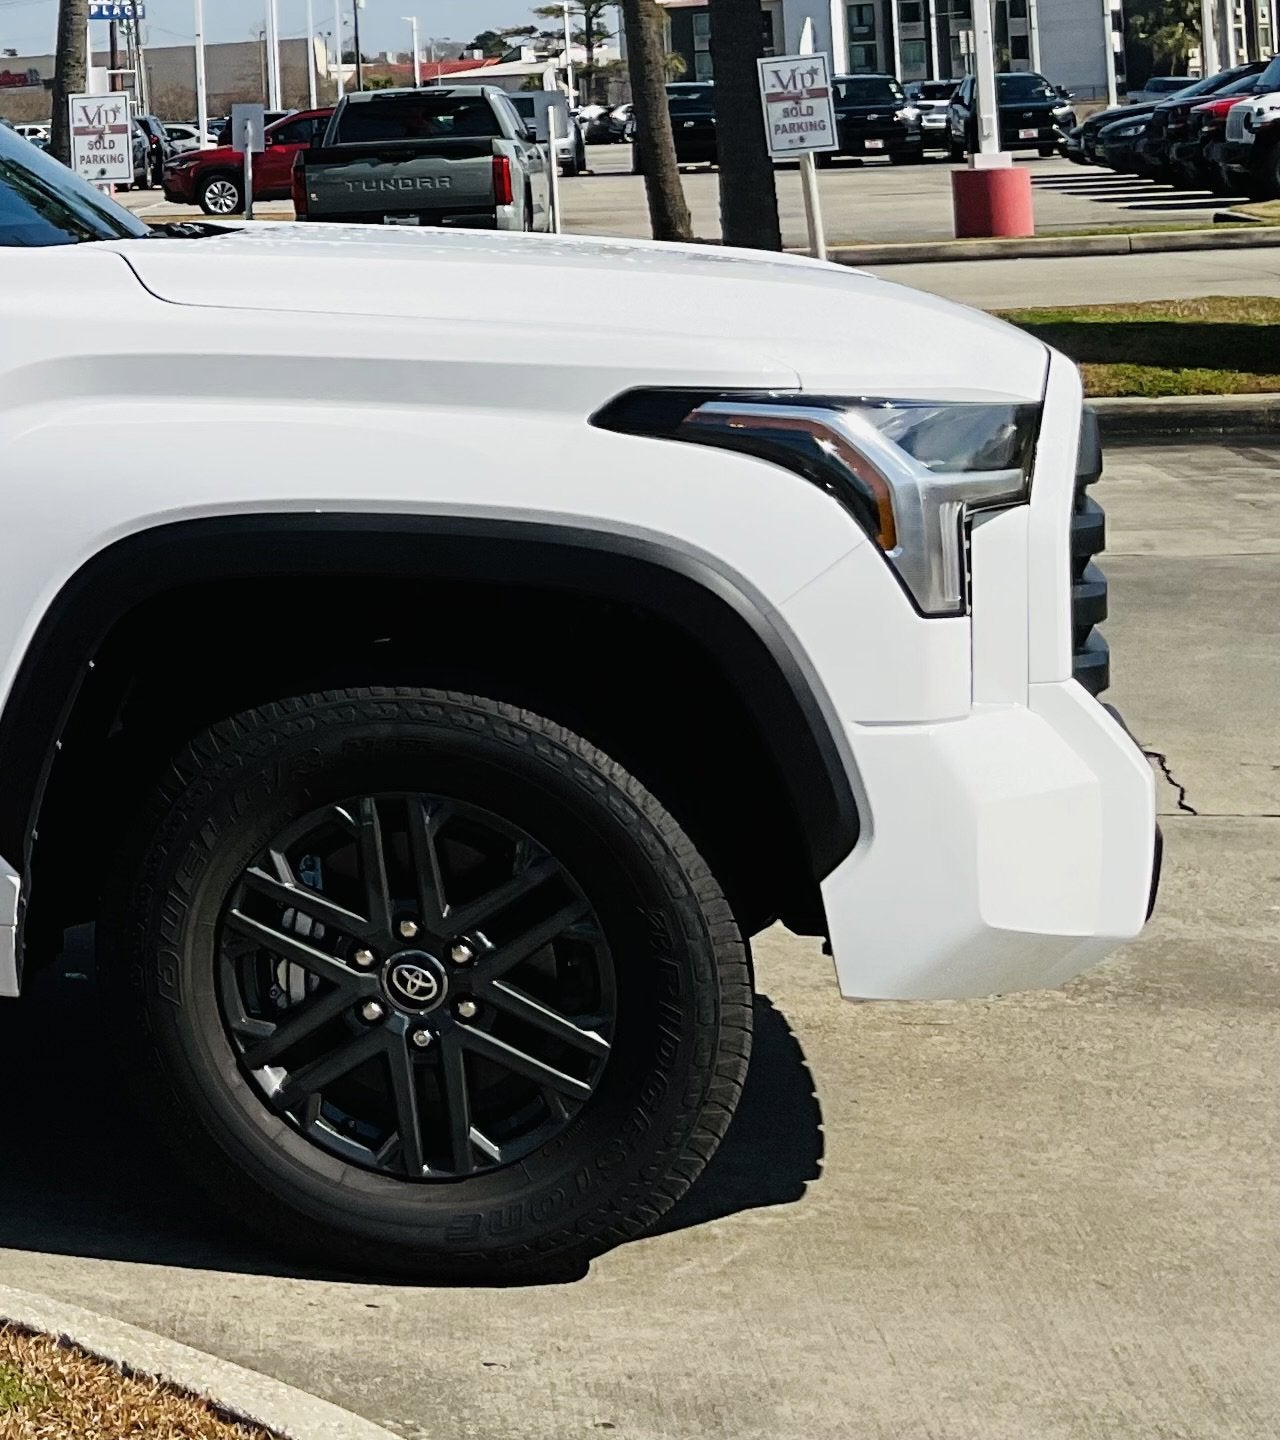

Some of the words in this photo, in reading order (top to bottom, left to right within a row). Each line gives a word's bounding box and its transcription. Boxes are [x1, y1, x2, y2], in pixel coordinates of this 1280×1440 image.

[782, 106, 814, 118] SOLD
[774, 120, 826, 135] PARKING
[87, 140, 115, 150] SOLD
[80, 153, 125, 165] PARKING
[344, 175, 452, 193] TUNDRA
